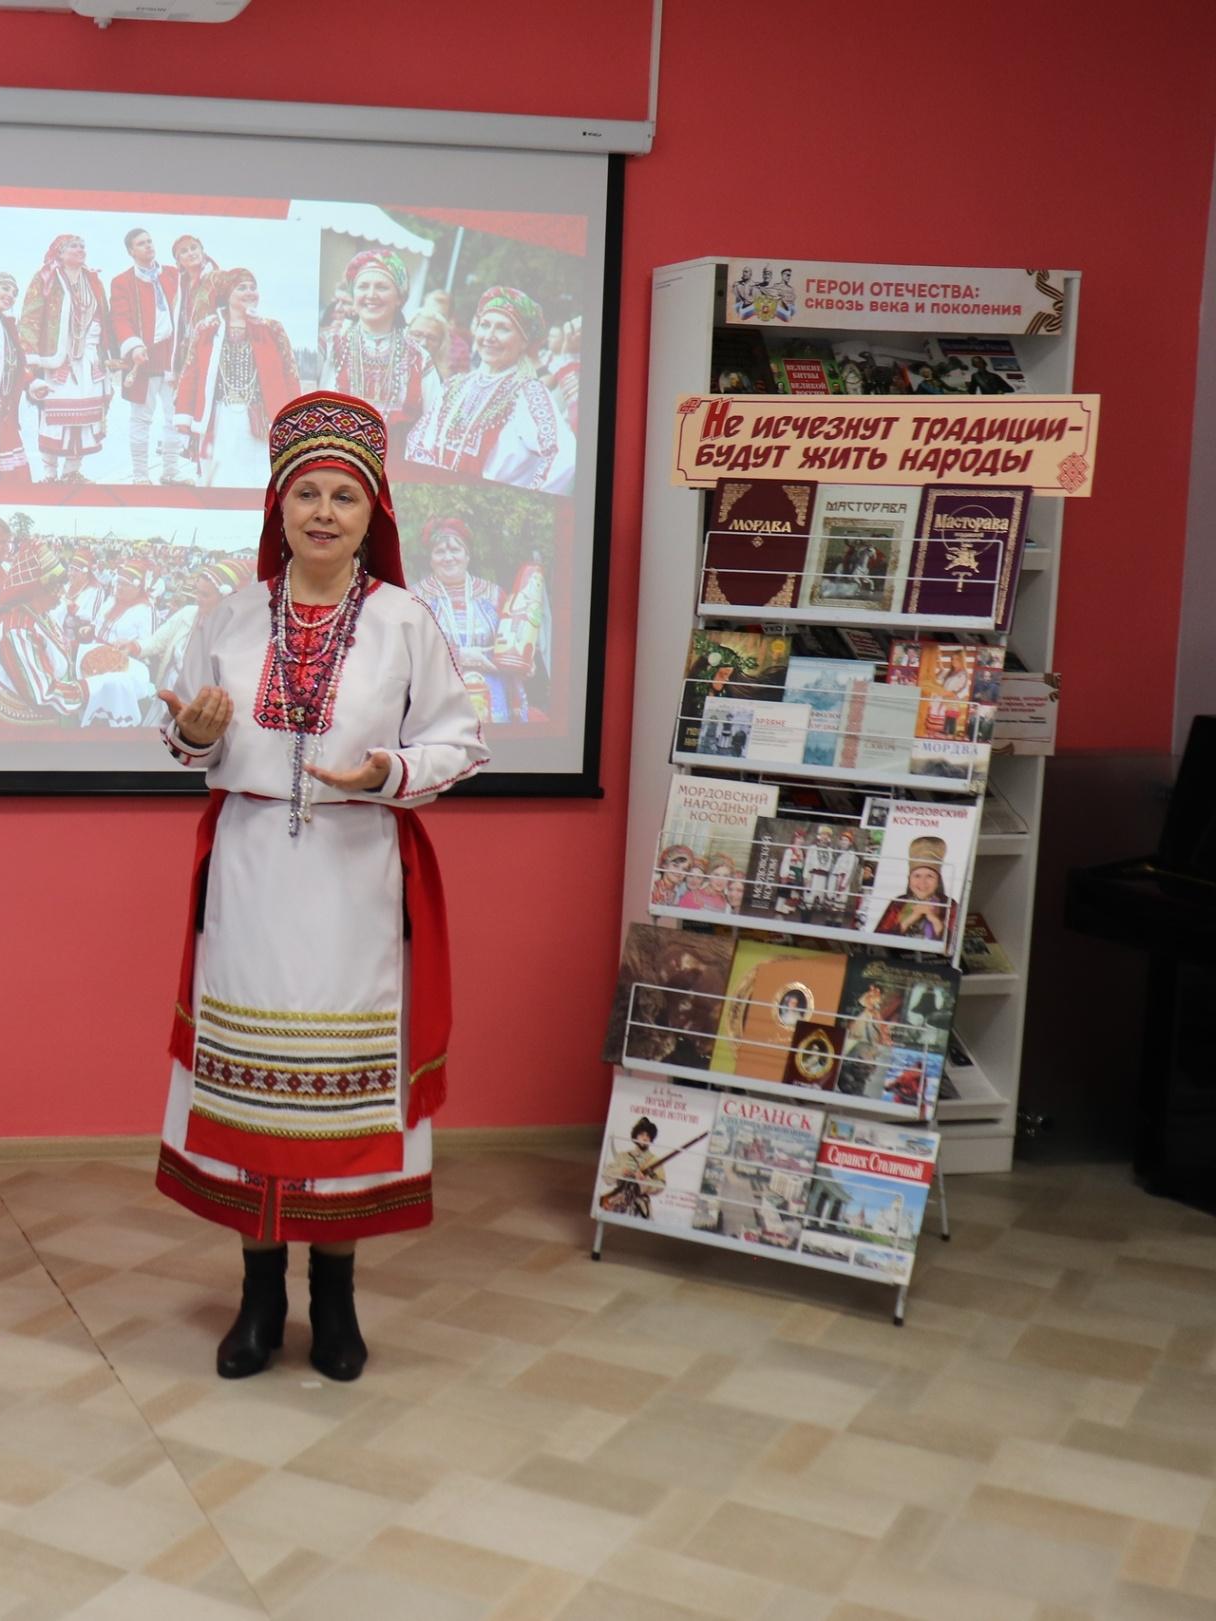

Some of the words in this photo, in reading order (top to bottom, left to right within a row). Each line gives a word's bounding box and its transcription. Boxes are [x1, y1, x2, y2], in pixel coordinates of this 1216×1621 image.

[805, 278, 865, 296] ГЕРОИ
[869, 281, 980, 300] ОТЕЧЕСТВА:
[804, 297, 864, 312] сквозь
[869, 299, 909, 313] века
[915, 301, 925, 313] и
[930, 301, 1022, 316] поколения
[701, 398, 744, 441] Не
[751, 415, 900, 441] исчезнут
[729, 518, 792, 534] МОРДВА
[934, 513, 1009, 533] Масторава
[922, 741, 979, 756] МОРДВА
[678, 784, 769, 806] МОРДОВСКИЙ
[683, 797, 759, 817] НАРОДНЫЙ
[895, 804, 969, 819] МОРДОВСКИЙ
[689, 811, 748, 827] КОСТЮМ
[893, 816, 940, 828] КОСТЮМ
[752, 835, 772, 900] МОДОВСКИЙ
[723, 1100, 812, 1131] САРАНСК
[827, 1145, 869, 1169] Саранск
[869, 1152, 924, 1180] Столичный
